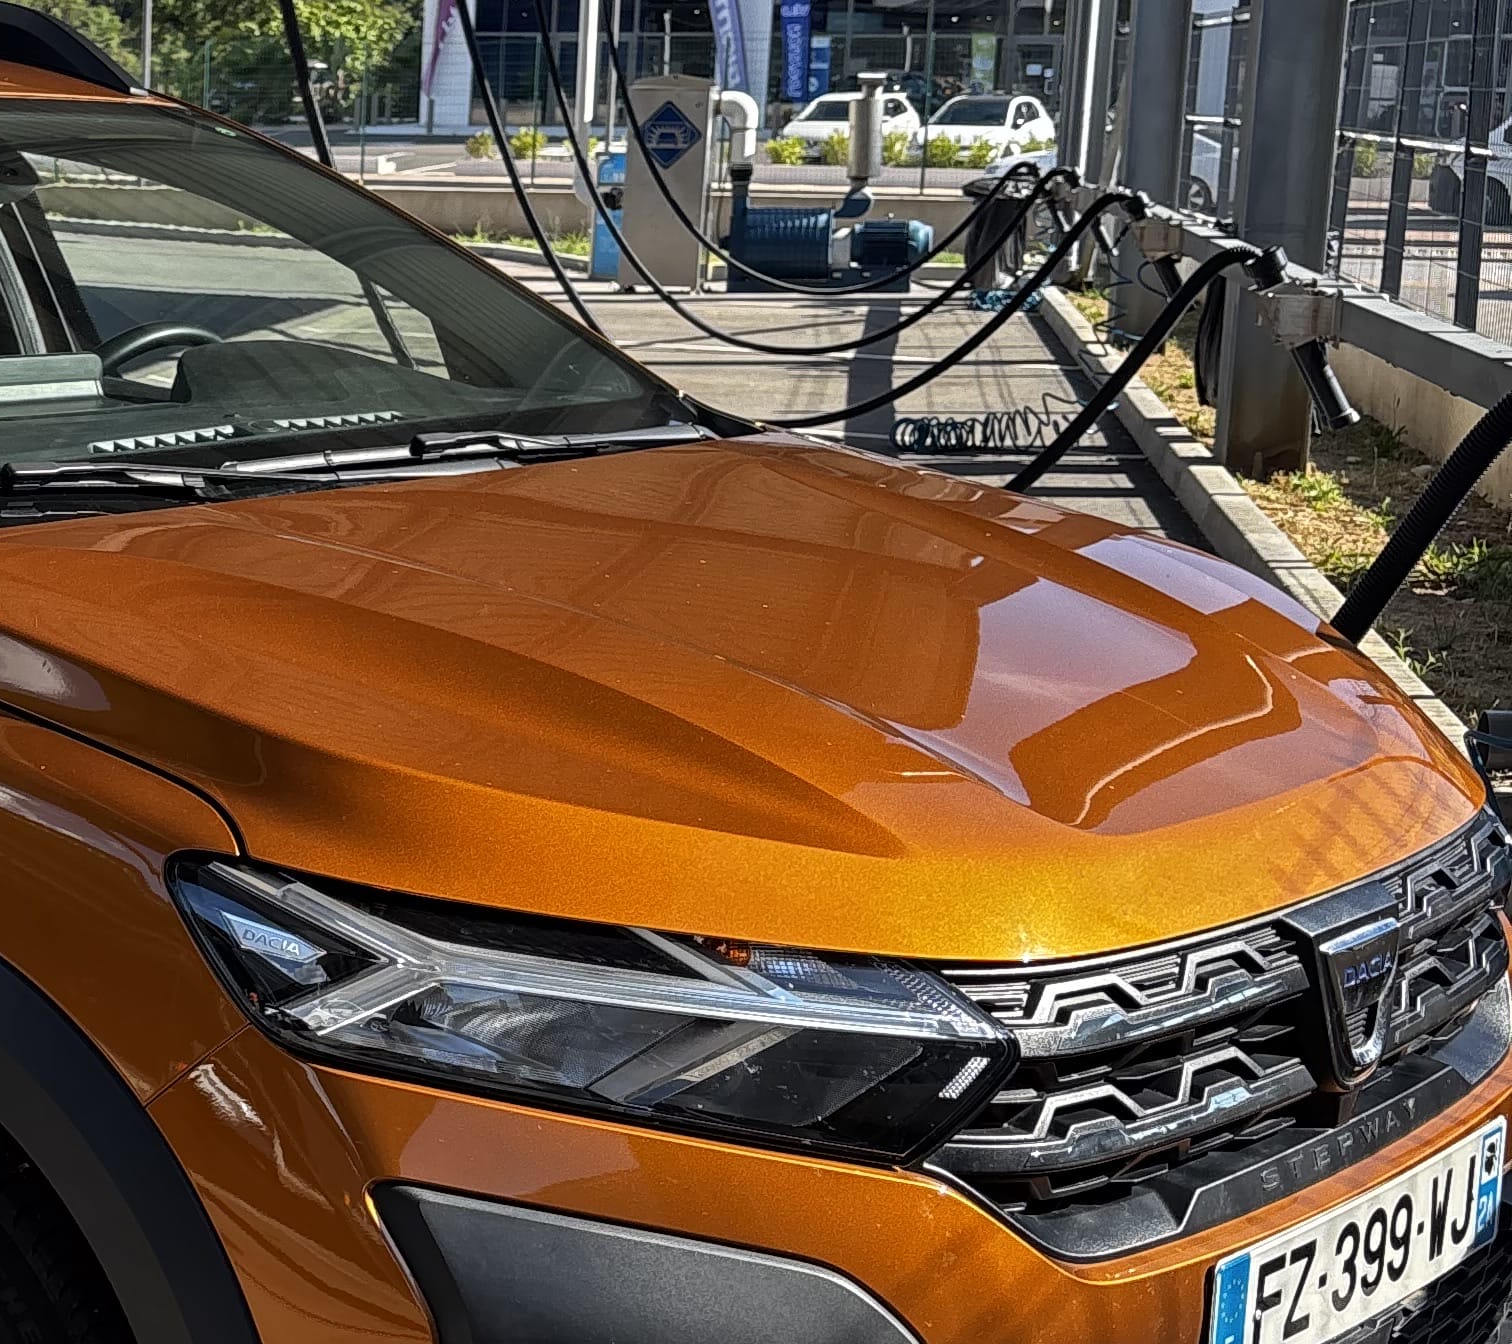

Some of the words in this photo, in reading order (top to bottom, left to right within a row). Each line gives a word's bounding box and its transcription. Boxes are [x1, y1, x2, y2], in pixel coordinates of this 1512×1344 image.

[242, 928, 301, 957] DACIA
[1343, 951, 1393, 989] DACIA
[1260, 1097, 1416, 1192] STEPWAY
